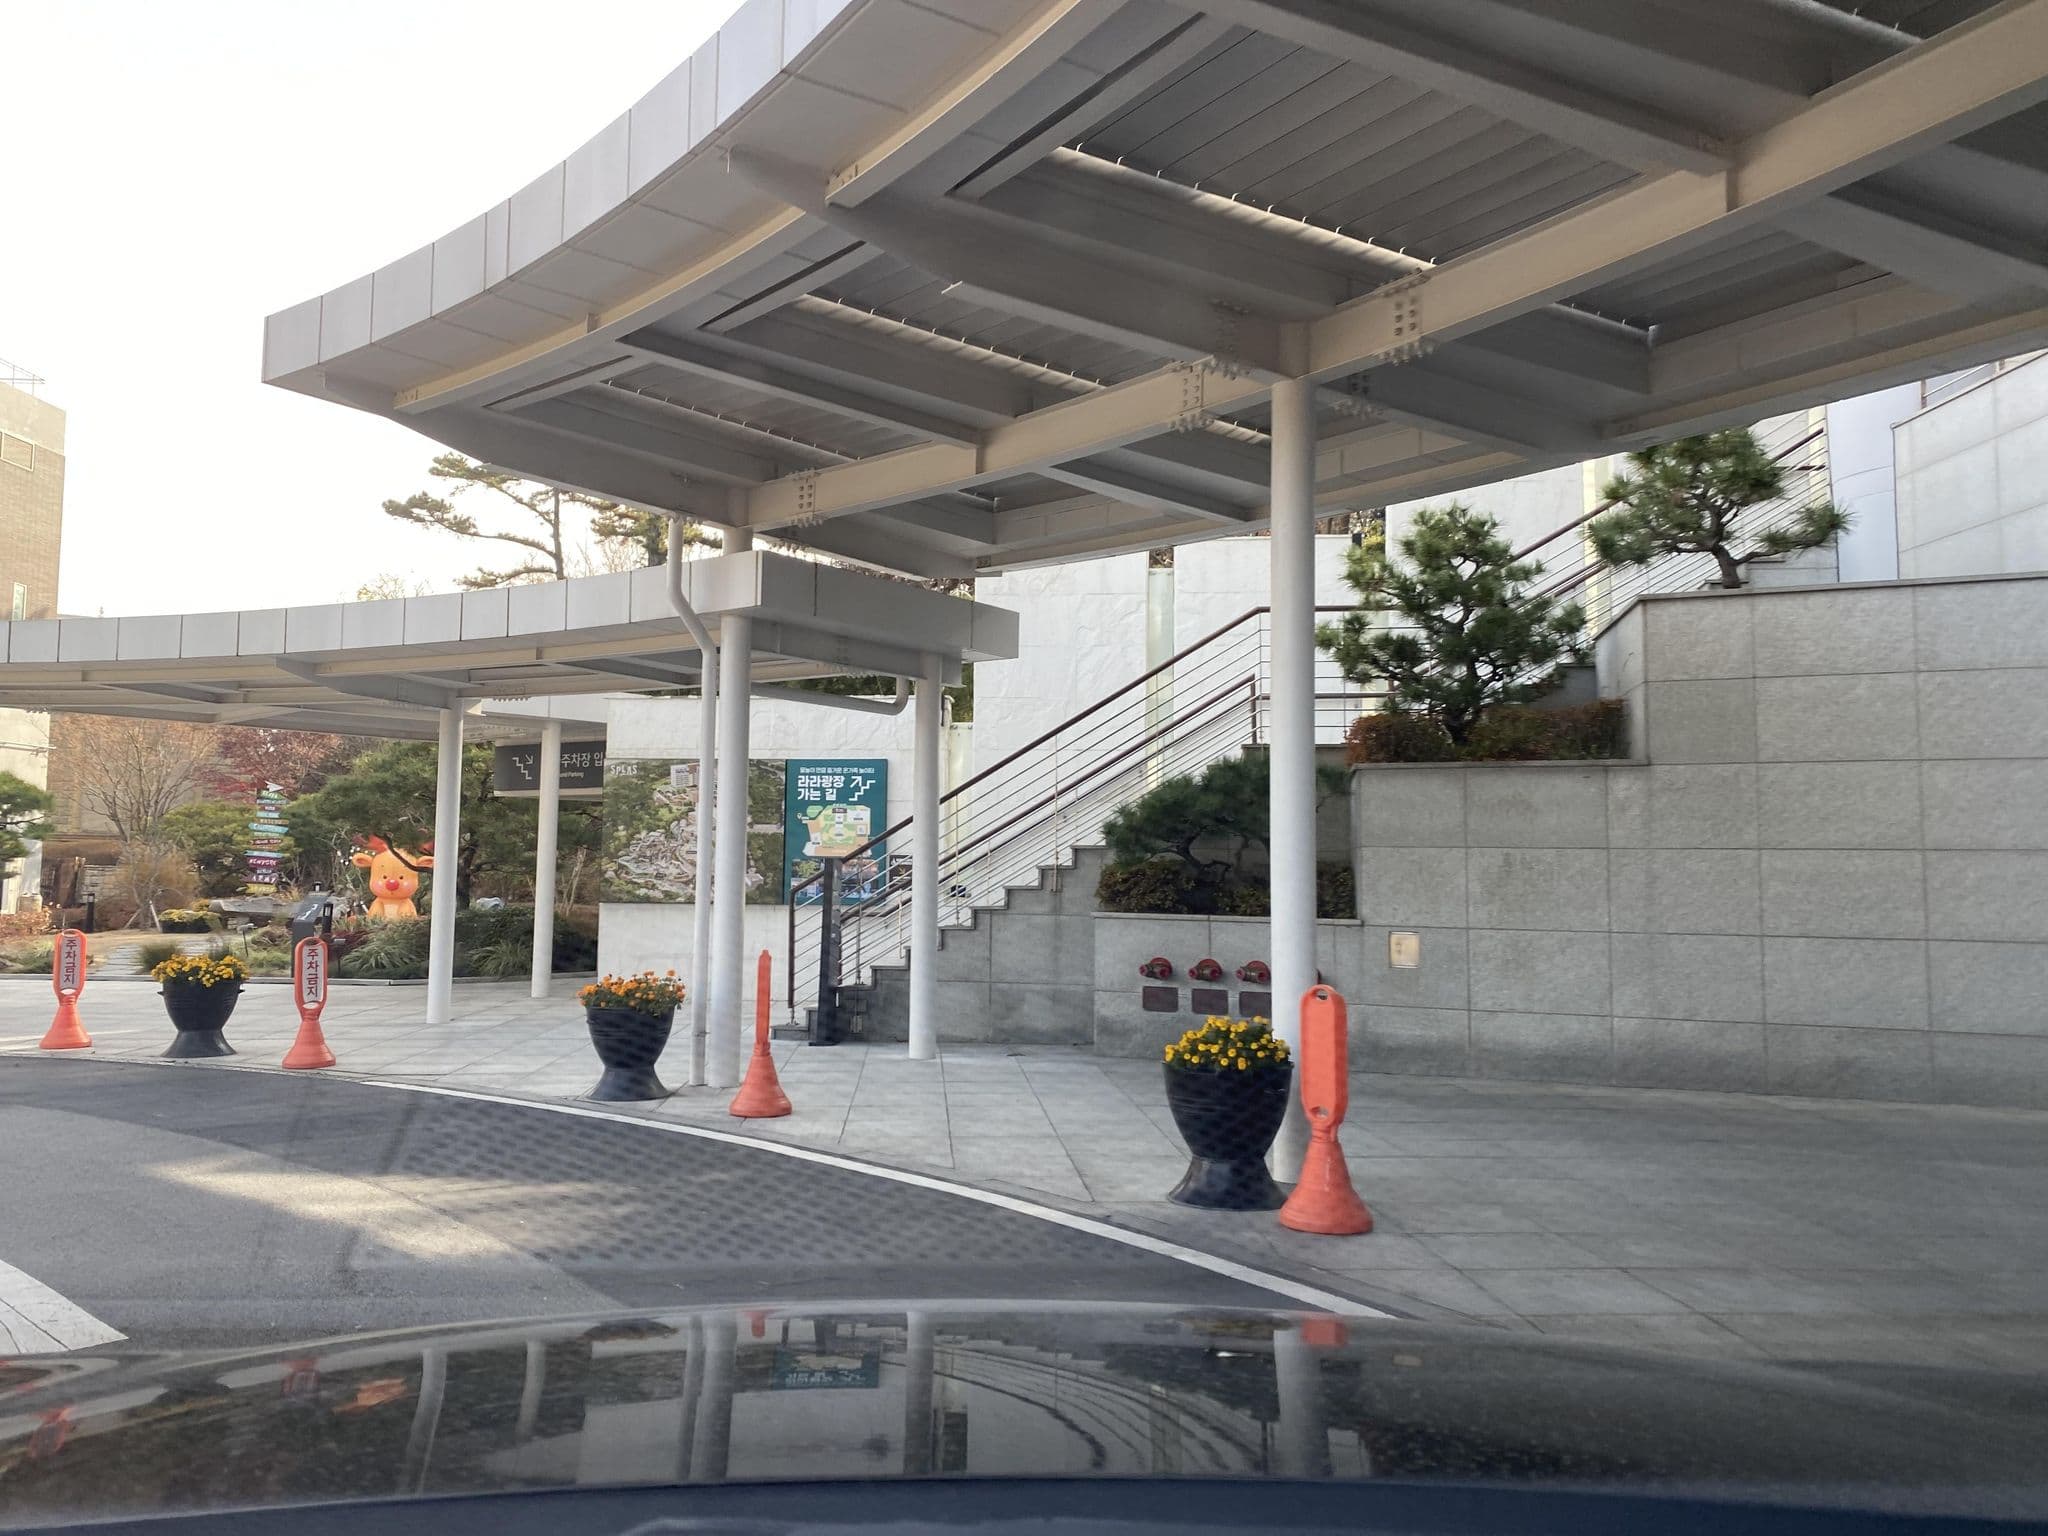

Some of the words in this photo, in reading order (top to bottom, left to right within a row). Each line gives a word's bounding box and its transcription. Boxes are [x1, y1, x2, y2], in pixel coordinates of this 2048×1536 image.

[561, 752, 591, 768] 주차장
[797, 775, 845, 788] 라라광장
[797, 788, 822, 801] 가는
[825, 788, 837, 801] 길
[63, 939, 78, 985] 주차금지
[306, 948, 320, 998] 주차금지
